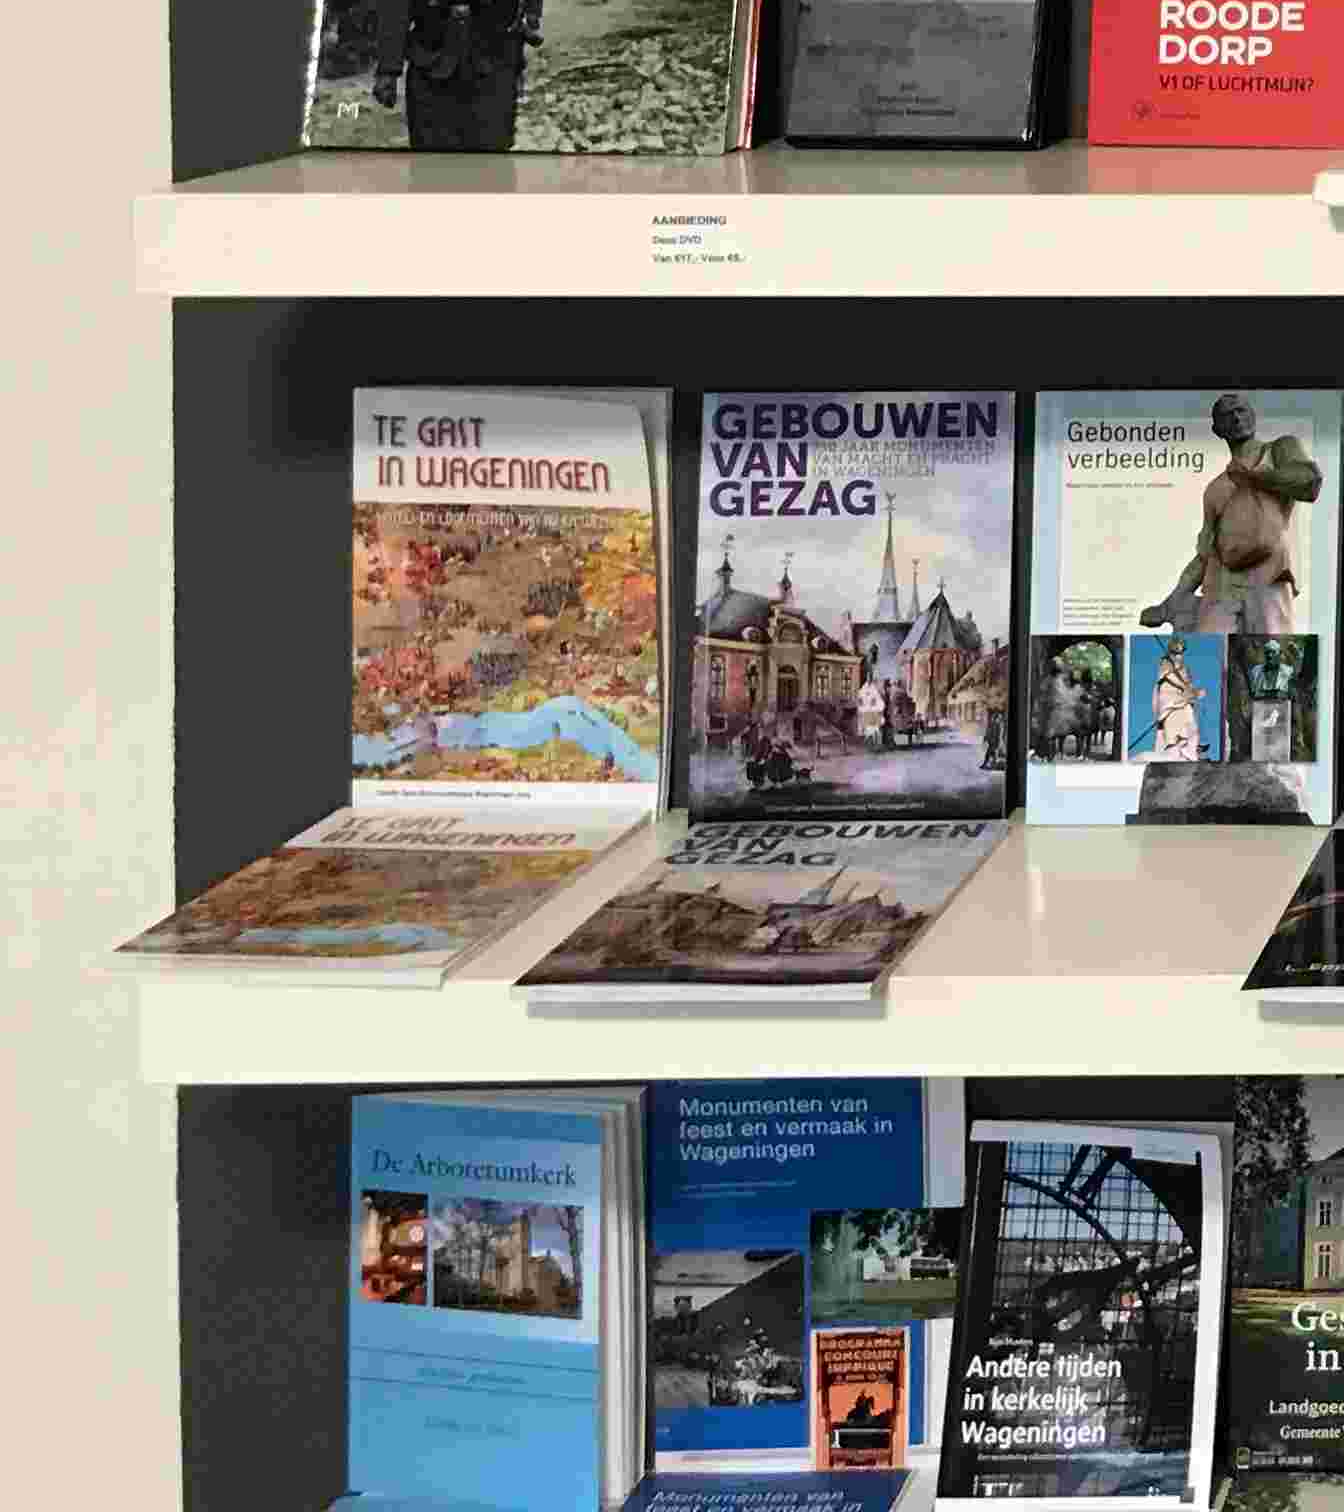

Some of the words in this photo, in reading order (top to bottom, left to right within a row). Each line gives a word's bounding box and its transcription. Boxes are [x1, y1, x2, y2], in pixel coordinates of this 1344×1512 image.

[1160, 0, 1305, 31] ROODE
[1159, 36, 1273, 65] DORP
[373, 415, 406, 447] TE
[417, 418, 485, 448] GAST
[712, 401, 997, 440] GEBOUWEN
[1067, 421, 1184, 442] Gebonden
[378, 456, 405, 486] IN
[416, 457, 610, 492] WAGENINGEN
[710, 442, 808, 478] VAN
[1069, 448, 1205, 472] verbeelding
[710, 480, 876, 516] GEZAG
[680, 1097, 825, 1117] Monumenten
[831, 1097, 868, 1112] van
[680, 1143, 816, 1165] Wageningen
[966, 1355, 1049, 1377] Andere
[1056, 1356, 1121, 1379] tijden
[1305, 1340, 1341, 1370] in
[964, 1389, 984, 1409] in
[991, 1388, 1088, 1412] kerkelijk
[960, 1421, 1105, 1448] Wageningen
